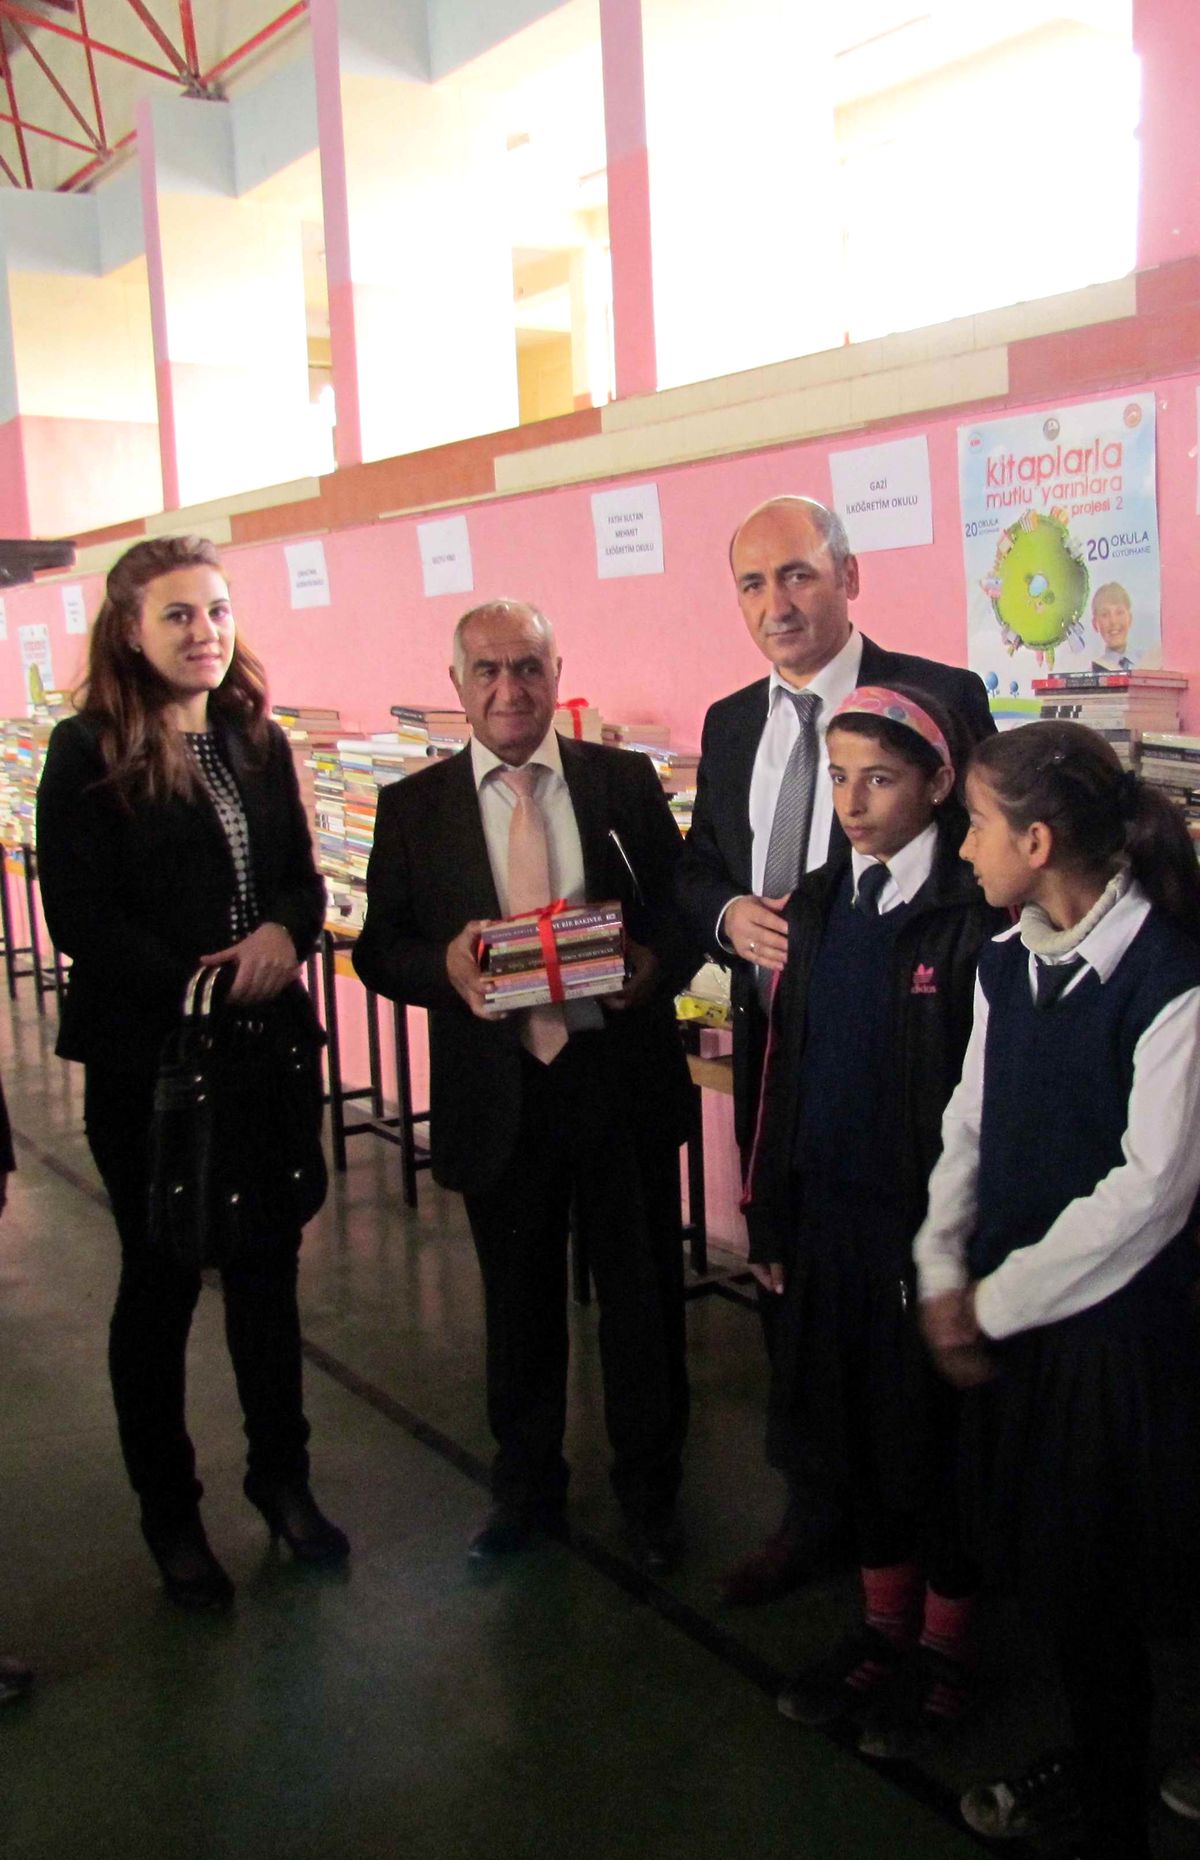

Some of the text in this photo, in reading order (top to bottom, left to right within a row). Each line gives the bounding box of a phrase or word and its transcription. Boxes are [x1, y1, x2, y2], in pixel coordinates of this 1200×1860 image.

[986, 438, 1123, 487] kitaplarla
[870, 478, 887, 490] GAZİ
[892, 496, 917, 508] OKULU
[986, 486, 1033, 510] mutlu
[1071, 496, 1123, 517] projesi 2
[965, 523, 977, 537] 20
[1086, 530, 1150, 562] 20 OKULA
